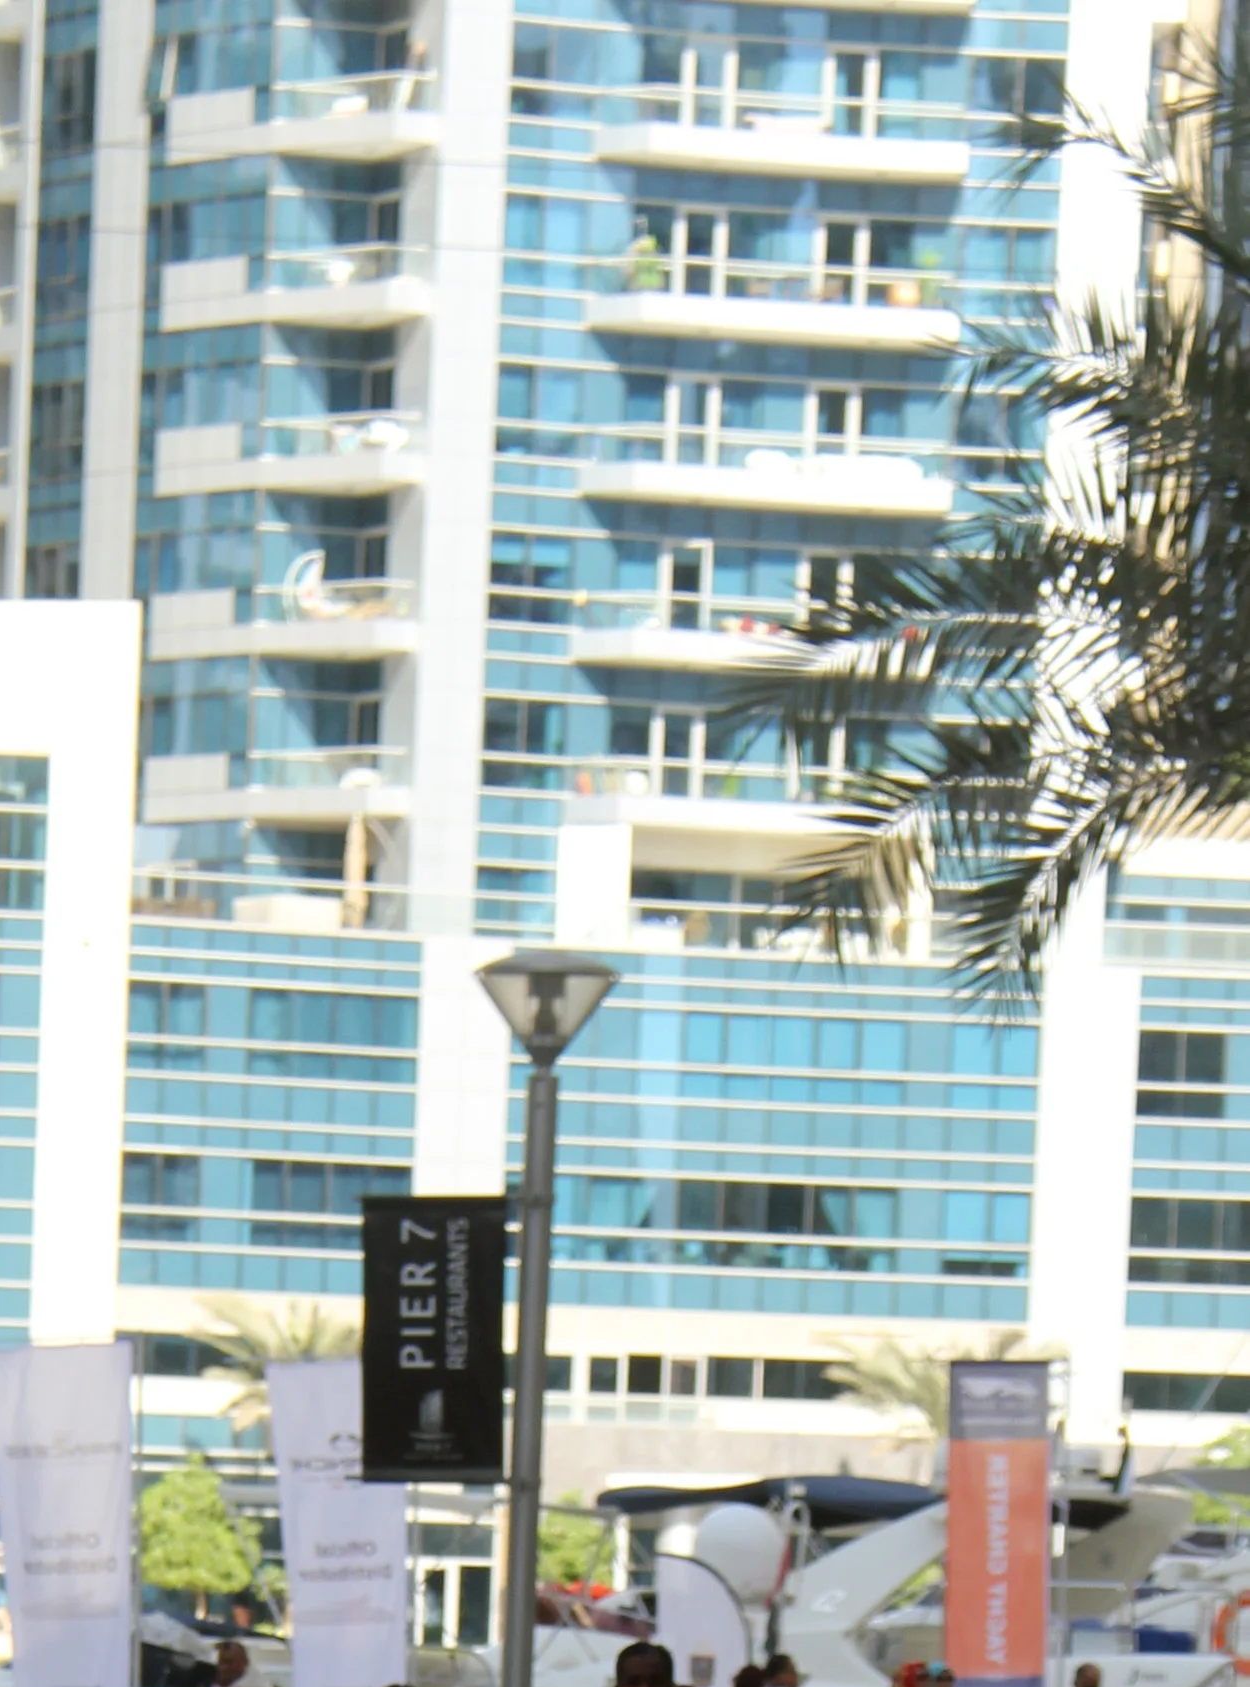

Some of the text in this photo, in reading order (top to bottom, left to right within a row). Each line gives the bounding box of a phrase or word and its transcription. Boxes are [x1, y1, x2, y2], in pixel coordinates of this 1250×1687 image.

[399, 1217, 438, 1369] PIER 7
[445, 1217, 470, 1369] RESTAURANTS
